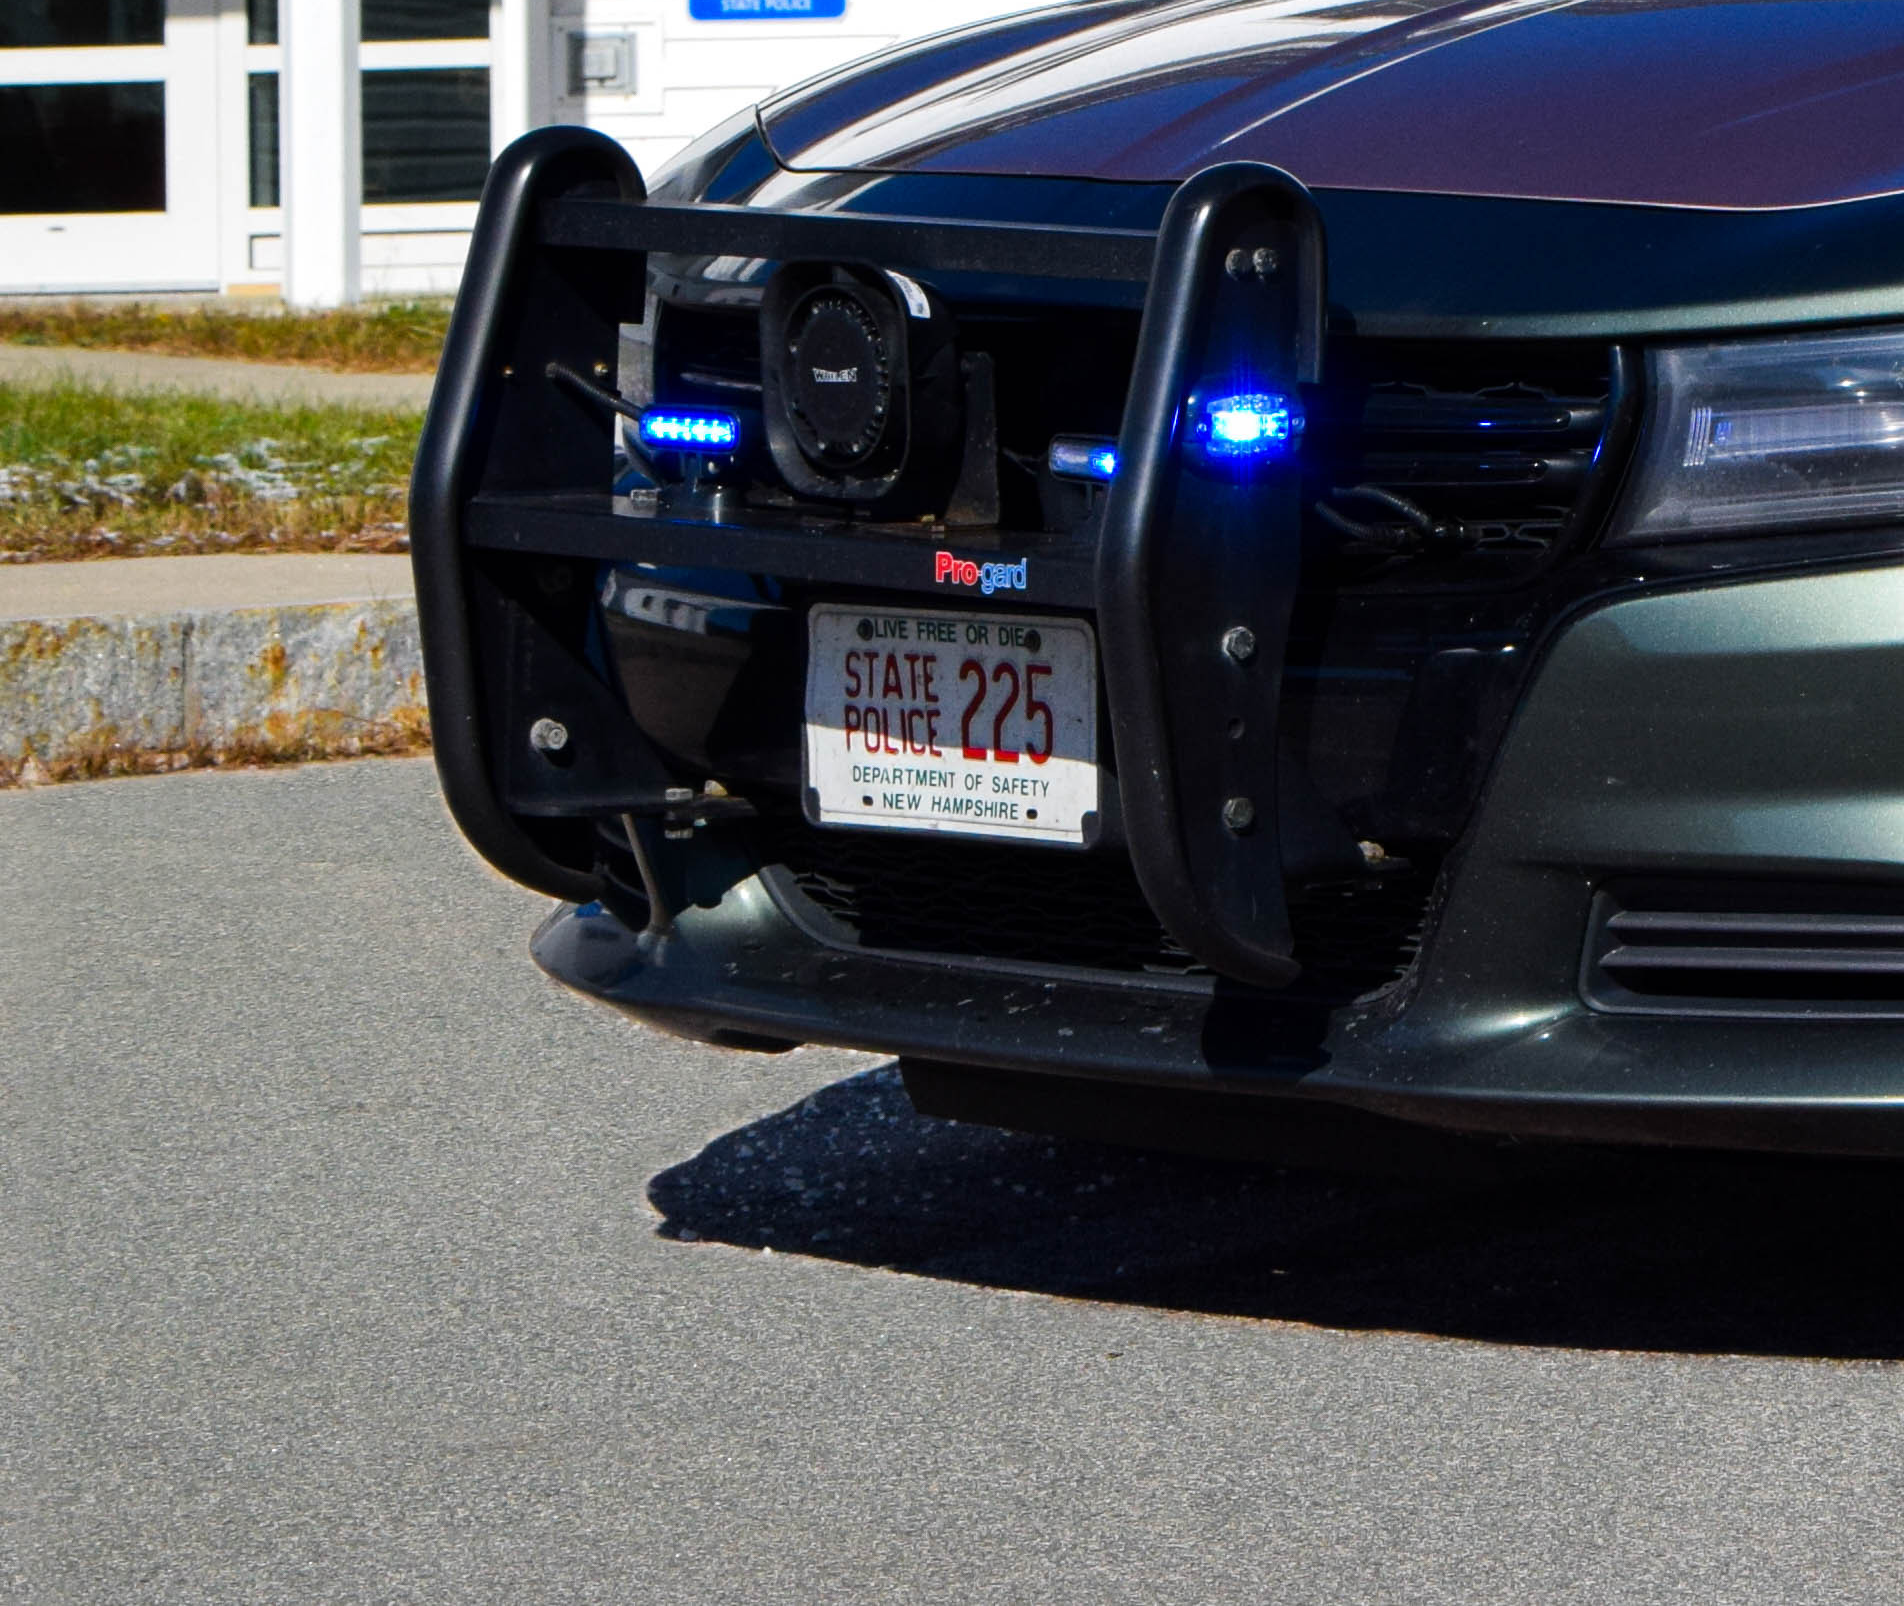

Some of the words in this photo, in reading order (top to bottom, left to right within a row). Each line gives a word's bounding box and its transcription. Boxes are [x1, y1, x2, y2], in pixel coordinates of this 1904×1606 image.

[935, 551, 1028, 594] Pro-gard
[875, 618, 908, 639] LIVE
[917, 622, 957, 643] FREE
[966, 625, 988, 644] OR
[999, 626, 1025, 645] DIE
[845, 651, 939, 703] STATE
[845, 705, 942, 757] POLICE
[959, 659, 1053, 764] 225
[853, 765, 956, 788] DEPARTMENT
[965, 773, 982, 791] OF
[992, 777, 1050, 798] SAFETY
[883, 793, 921, 811] NEW
[932, 795, 1018, 820] HAMPSHIRE
